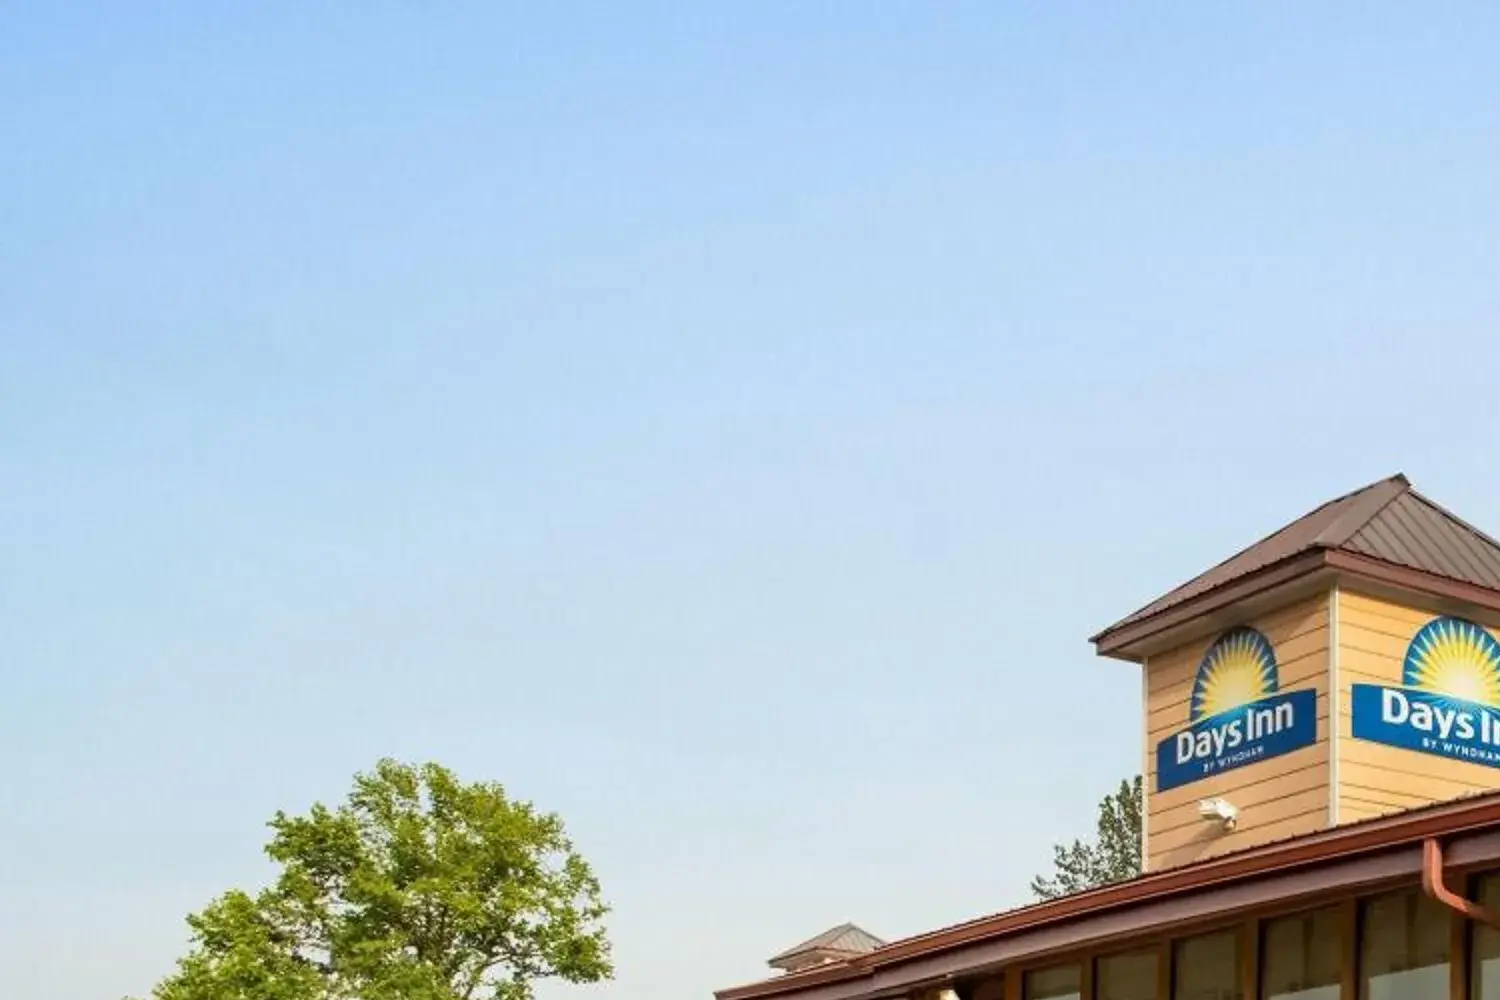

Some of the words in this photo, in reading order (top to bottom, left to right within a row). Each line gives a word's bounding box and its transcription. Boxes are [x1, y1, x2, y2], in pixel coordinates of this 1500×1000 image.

[1176, 719, 1242, 765] Days
[1247, 701, 1294, 741] Inn
[1382, 687, 1475, 739] Days
